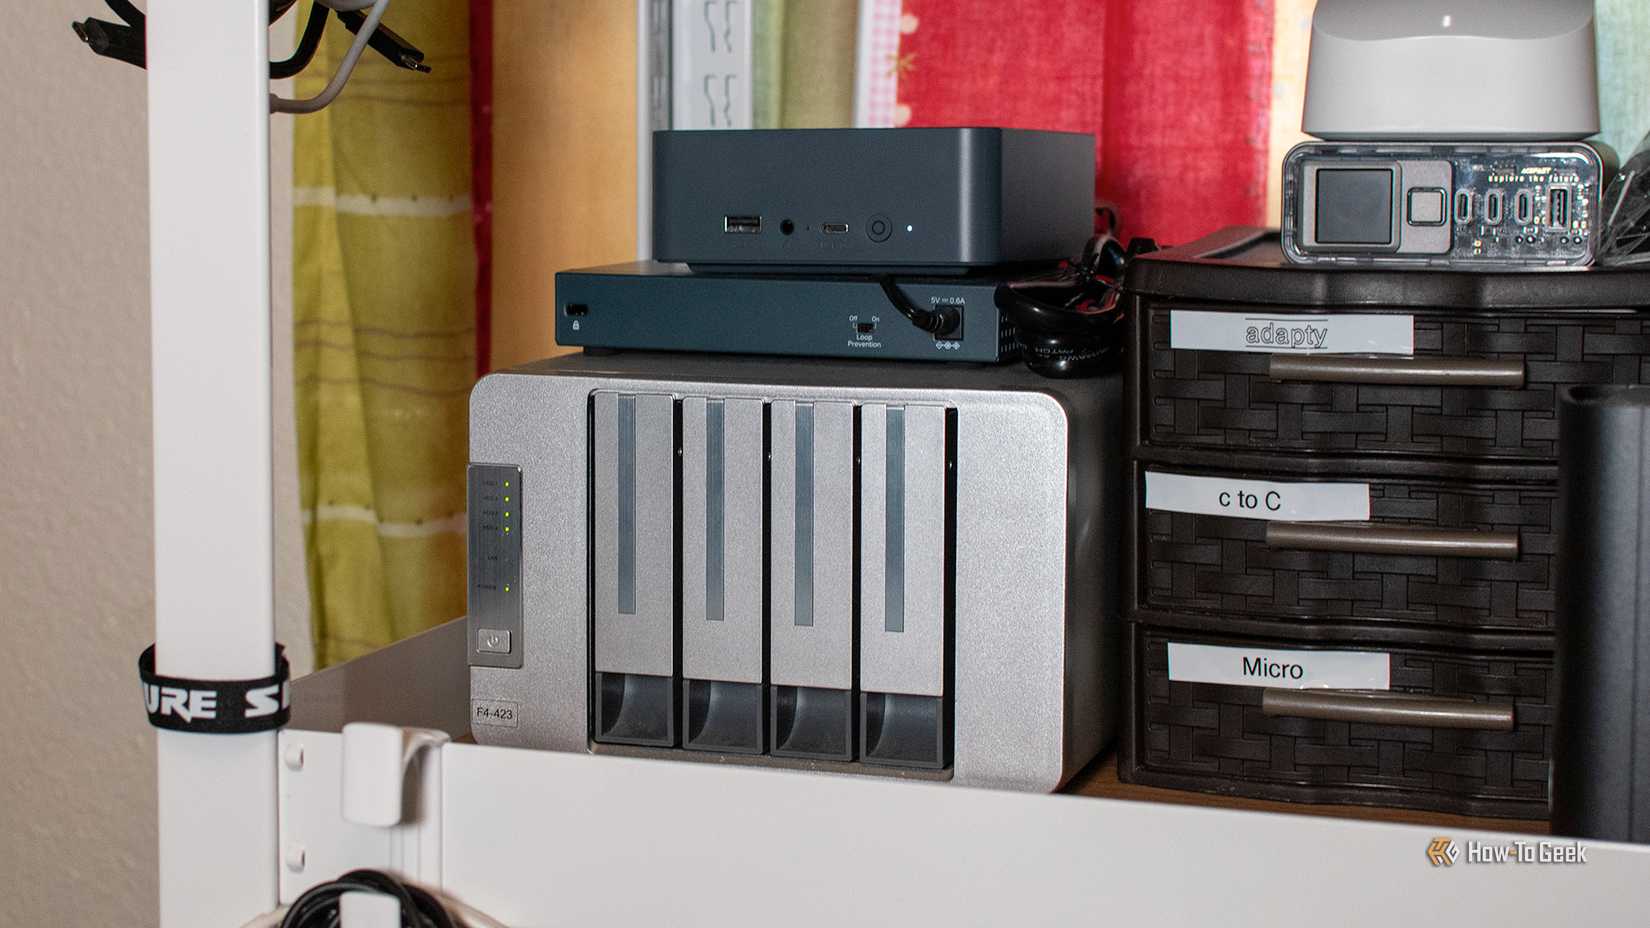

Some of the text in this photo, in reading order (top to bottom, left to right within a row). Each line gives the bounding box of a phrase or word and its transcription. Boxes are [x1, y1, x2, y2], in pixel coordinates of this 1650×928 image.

[847, 340, 882, 348] Prevention
[1245, 321, 1329, 349] adapty
[1219, 490, 1281, 511] c to C
[1242, 656, 1304, 680] Micro
[476, 706, 513, 719] F4-423
